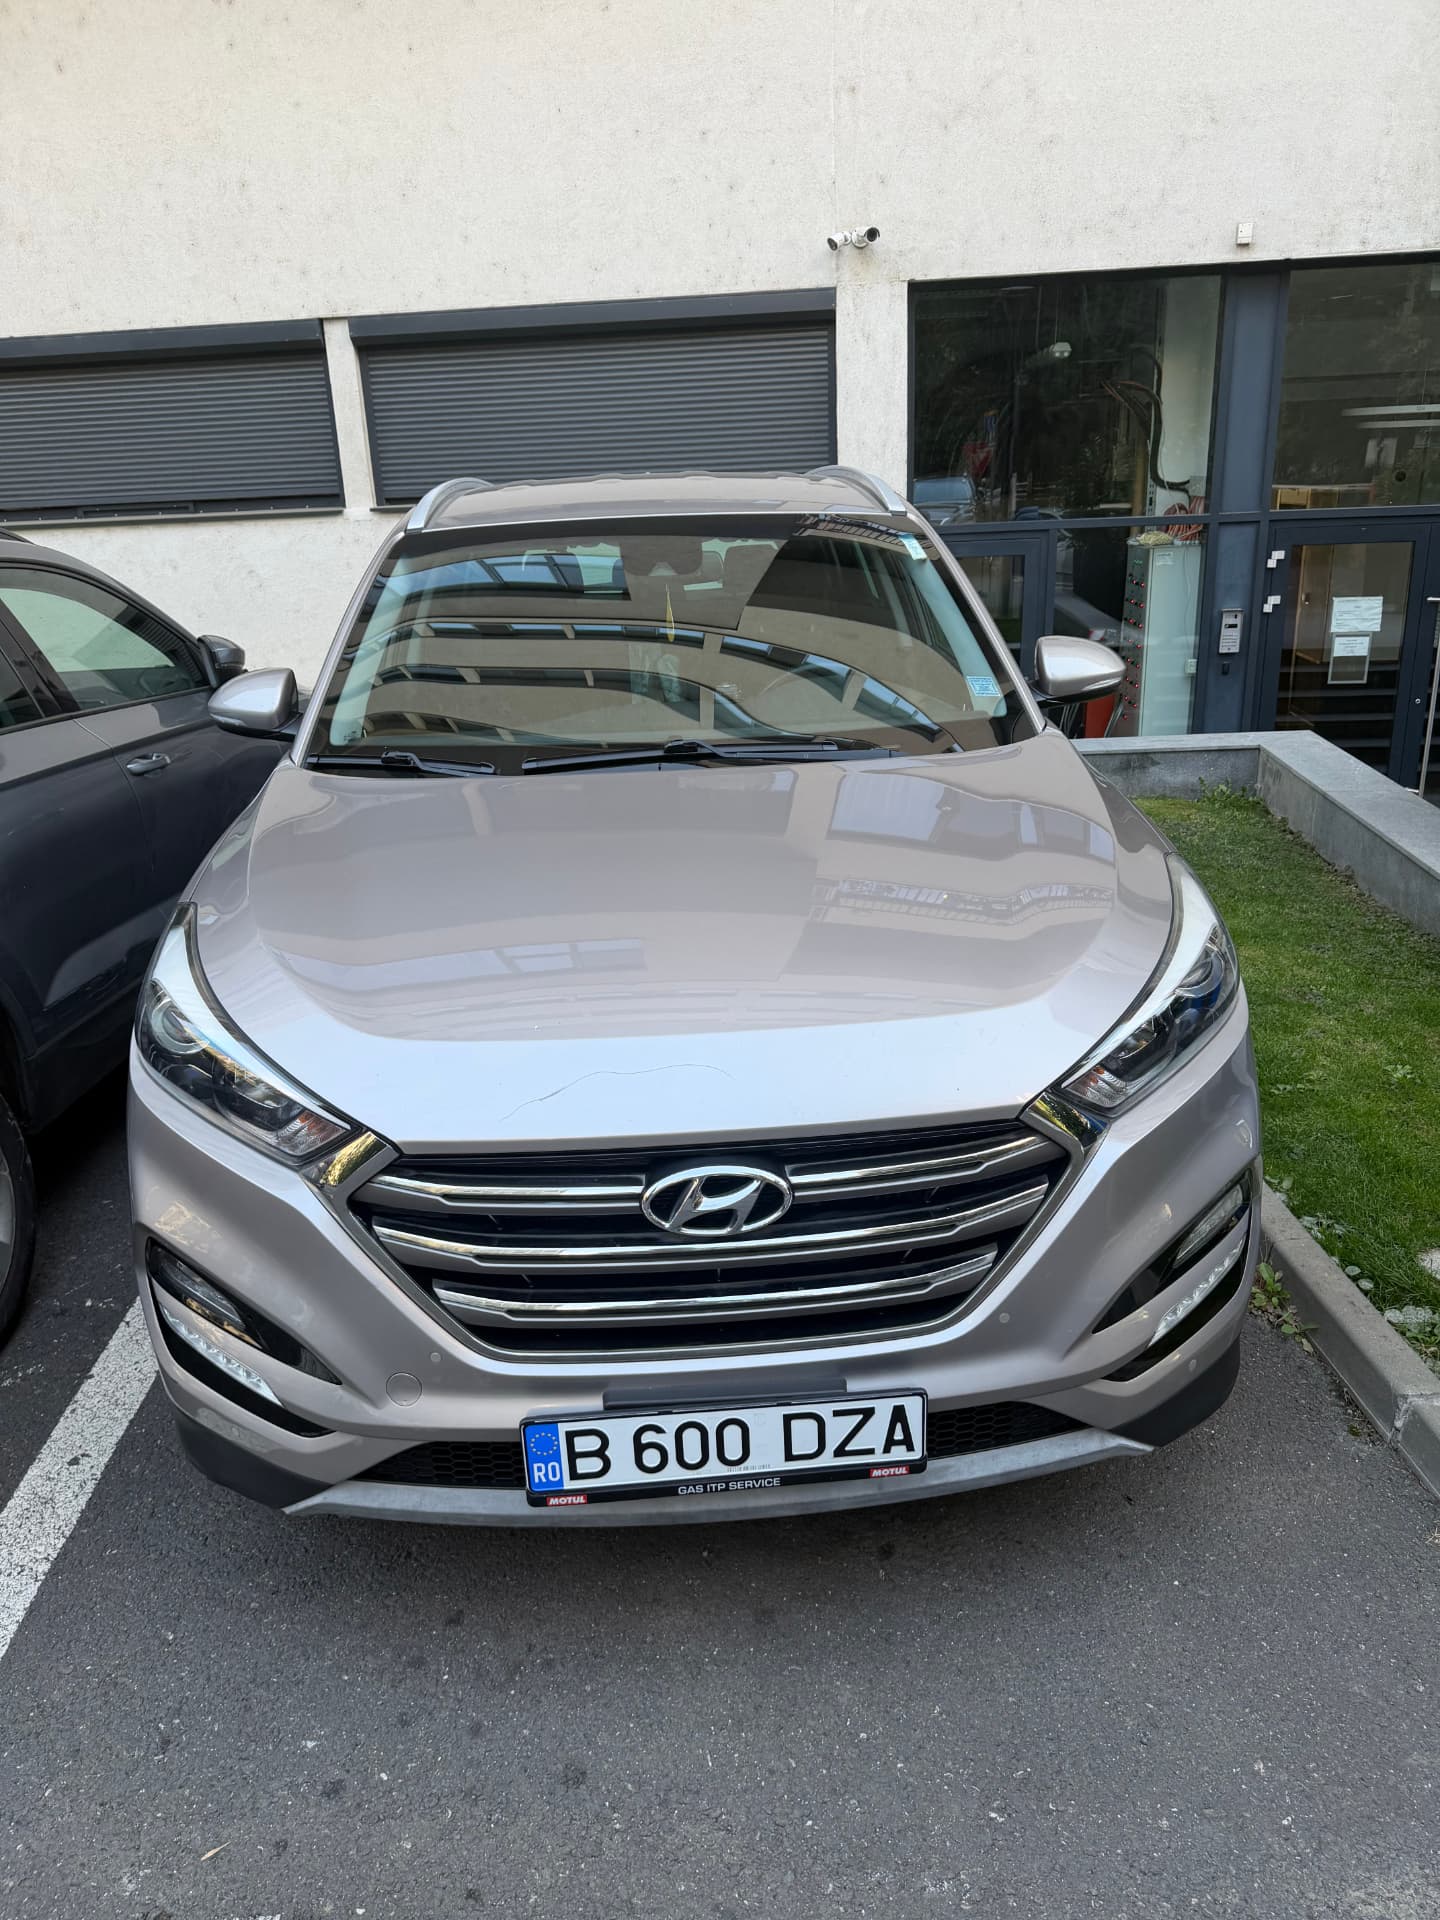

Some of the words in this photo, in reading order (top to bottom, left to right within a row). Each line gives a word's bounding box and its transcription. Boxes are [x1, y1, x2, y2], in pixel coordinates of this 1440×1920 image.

[565, 1428, 611, 1481] B
[633, 1418, 750, 1474] 600
[783, 1404, 915, 1462] DZA
[533, 1461, 560, 1483] RO
[872, 1467, 908, 1477] MOTUL
[678, 1484, 704, 1496] GAS
[707, 1482, 726, 1492] ITP
[729, 1478, 781, 1490] SERVICE
[549, 1496, 585, 1505] MOTUL
